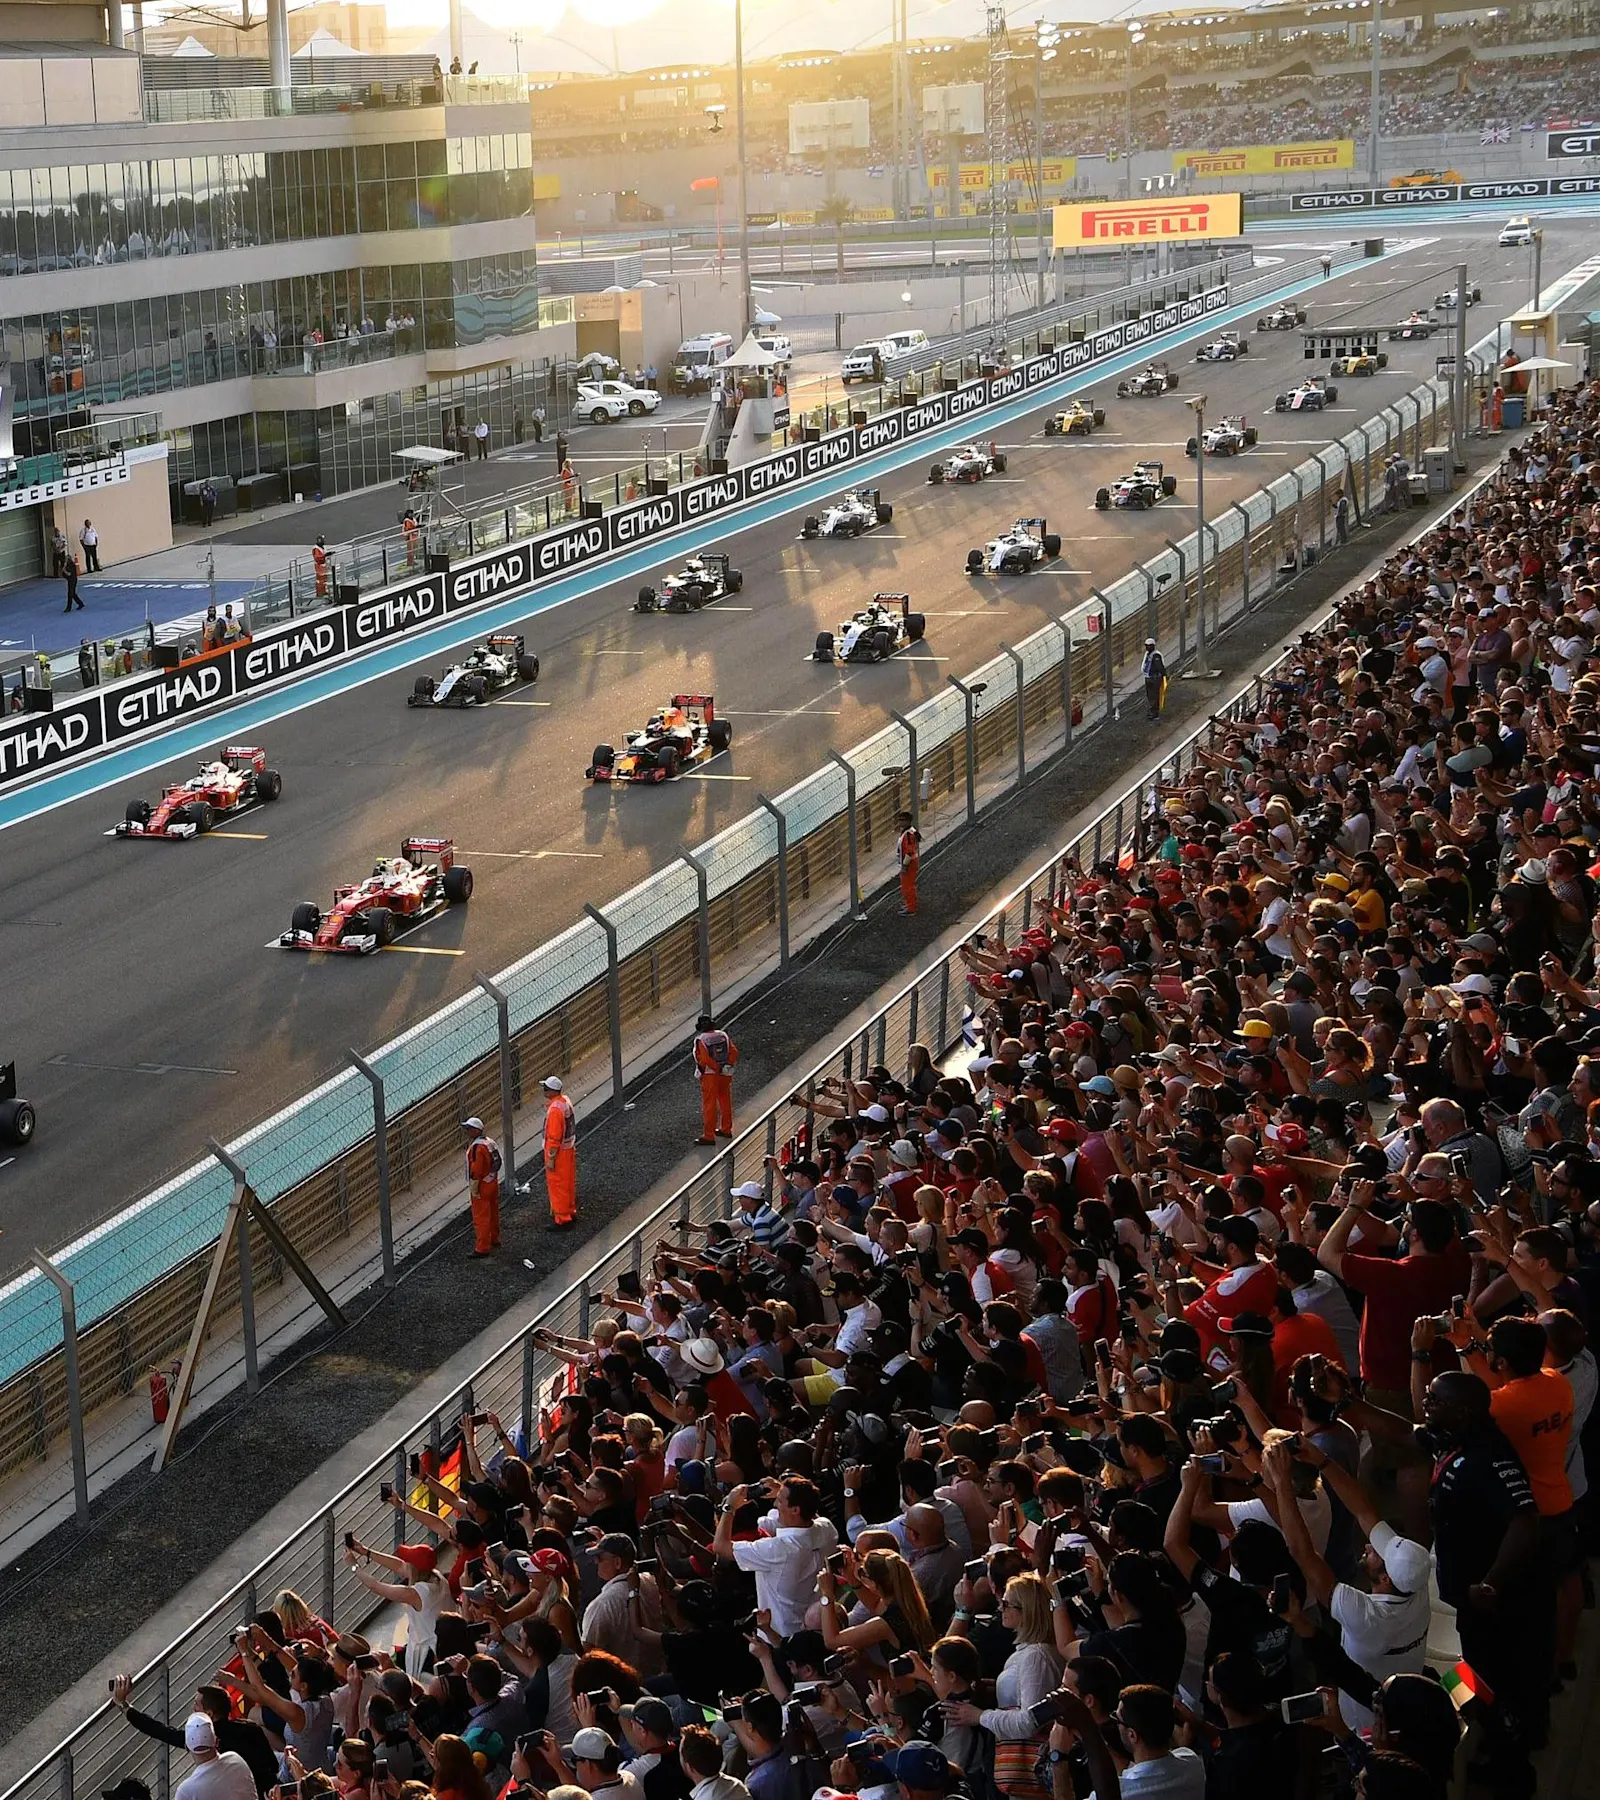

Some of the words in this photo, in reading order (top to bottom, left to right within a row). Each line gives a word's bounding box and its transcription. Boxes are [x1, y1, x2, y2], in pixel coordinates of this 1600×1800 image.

[1186, 154, 1246, 174] PIRELLI
[1274, 147, 1338, 168] PIRELLI
[1300, 194, 1364, 208] ETIHAD
[1382, 188, 1449, 203] ETIHAD
[1469, 183, 1539, 198] ETIHAD
[1081, 203, 1210, 239] PIRELLI
[1181, 299, 1203, 320] ETIHAD
[1206, 291, 1226, 310] ETIHAD
[1126, 320, 1150, 341] ETIHAD
[1155, 309, 1177, 330] ETIHAD
[1096, 332, 1121, 354] ETIHAD
[1063, 344, 1090, 368] ETIHAD
[1029, 361, 1057, 382] ETIHAD
[991, 373, 1022, 397] ETIHAD
[951, 388, 984, 414] ETIHAD
[907, 403, 943, 431] ETIHAD
[859, 420, 898, 450] ETIHAD
[807, 441, 850, 469] ETIHAD
[750, 457, 797, 491] ETIHAD
[686, 479, 738, 514] ETIHAD
[617, 500, 674, 539] ETIHAD
[540, 526, 603, 570] ETIHAD
[454, 555, 524, 601] ETIHAD
[356, 587, 434, 639] ETIHAD
[245, 624, 335, 681] ETIHAD
[118, 665, 222, 726] ETIHAD
[1498, 1468, 1520, 1478] EPSON
